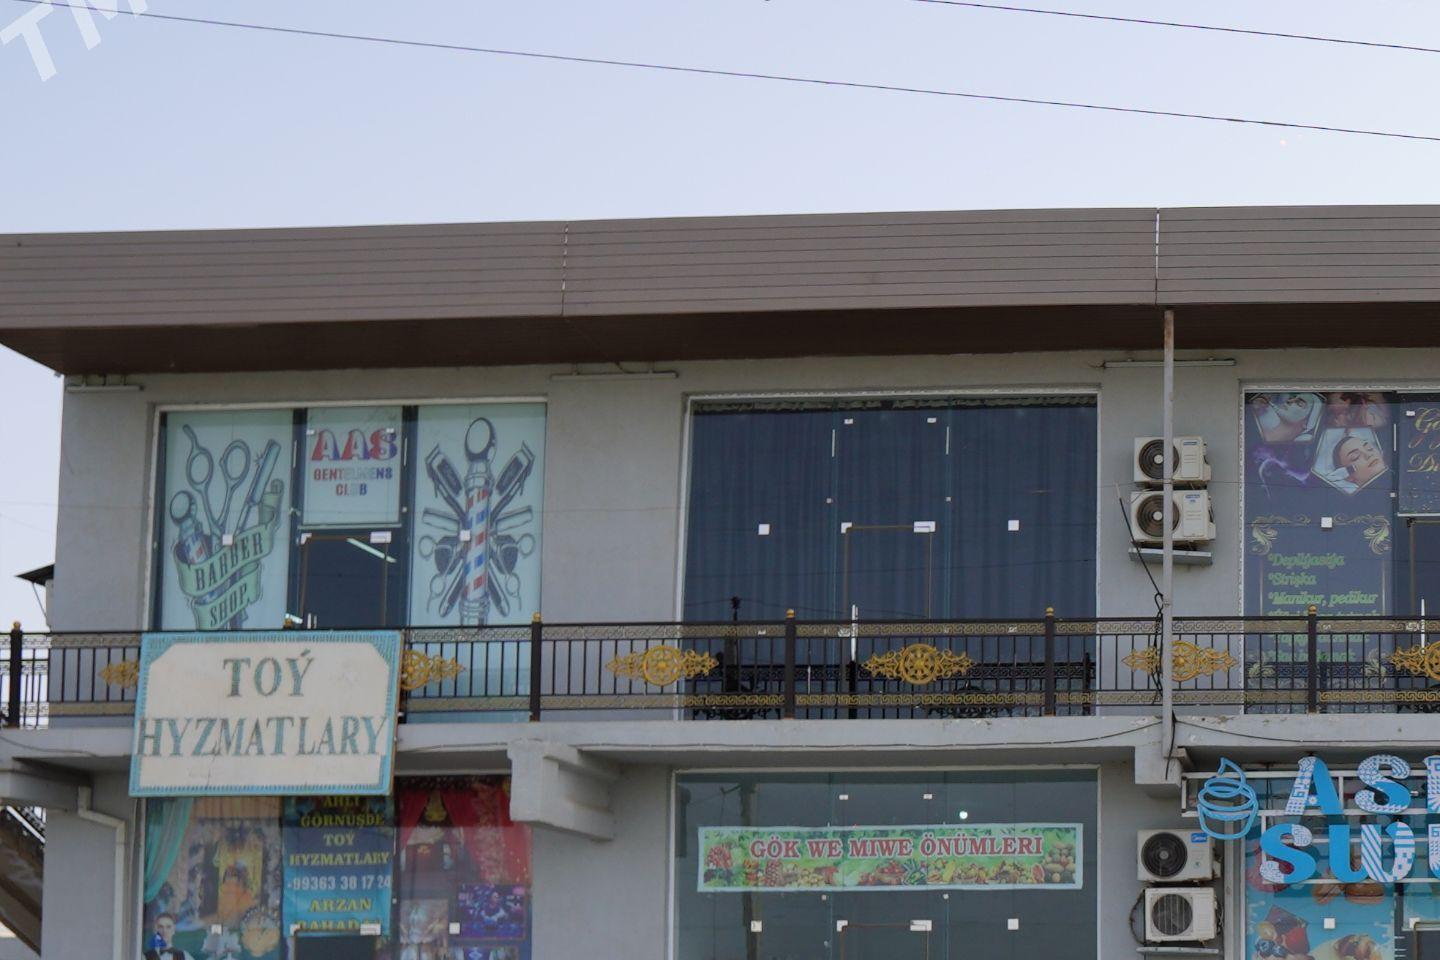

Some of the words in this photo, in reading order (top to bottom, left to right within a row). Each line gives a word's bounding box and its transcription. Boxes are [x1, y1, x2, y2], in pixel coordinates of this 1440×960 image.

[311, 428, 398, 461] AAS
[194, 531, 264, 592] BARBER
[210, 584, 248, 628] SHOP
[222, 648, 316, 698] TOÝ
[138, 713, 389, 757] HYZMATLARY
[751, 836, 800, 857] GÖK
[808, 839, 842, 857] WE
[850, 838, 913, 857] MIWE
[920, 834, 1044, 857] ÖNÜMLERI
